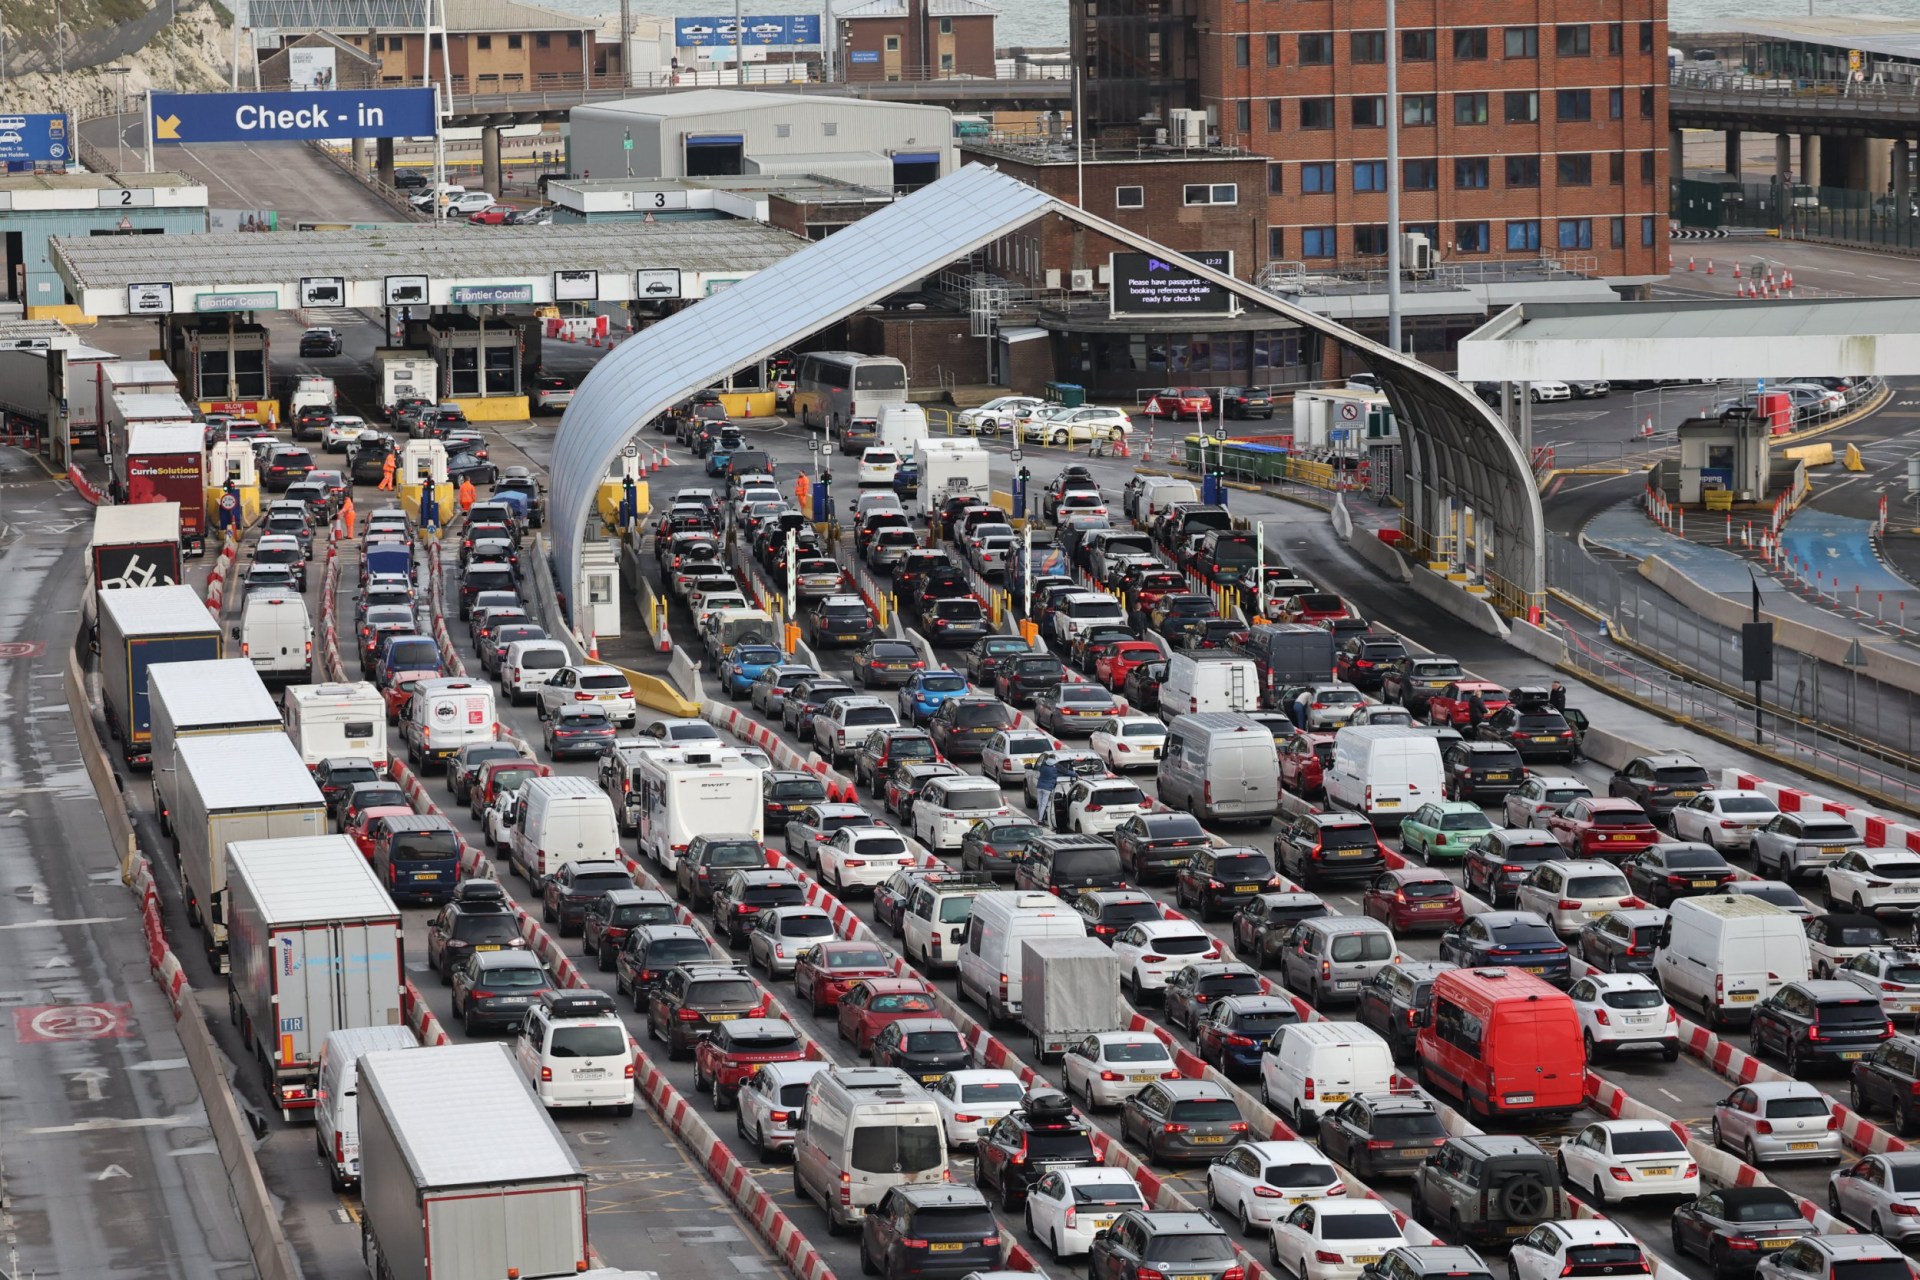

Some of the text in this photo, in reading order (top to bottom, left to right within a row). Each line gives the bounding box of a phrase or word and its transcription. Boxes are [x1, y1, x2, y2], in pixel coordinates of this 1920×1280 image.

[235, 103, 328, 130] Check
[358, 102, 384, 127] in
[121, 190, 132, 205] 2
[655, 193, 666, 208] 3
[1168, 279, 1200, 287] passports
[455, 289, 530, 301] Frontier Control
[1130, 287, 1155, 295] booking
[200, 294, 275, 309] Frontier Control
[1142, 296, 1160, 304] ready
[131, 467, 199, 475] CurrieSolutions
[282, 1018, 301, 1030] TIR
